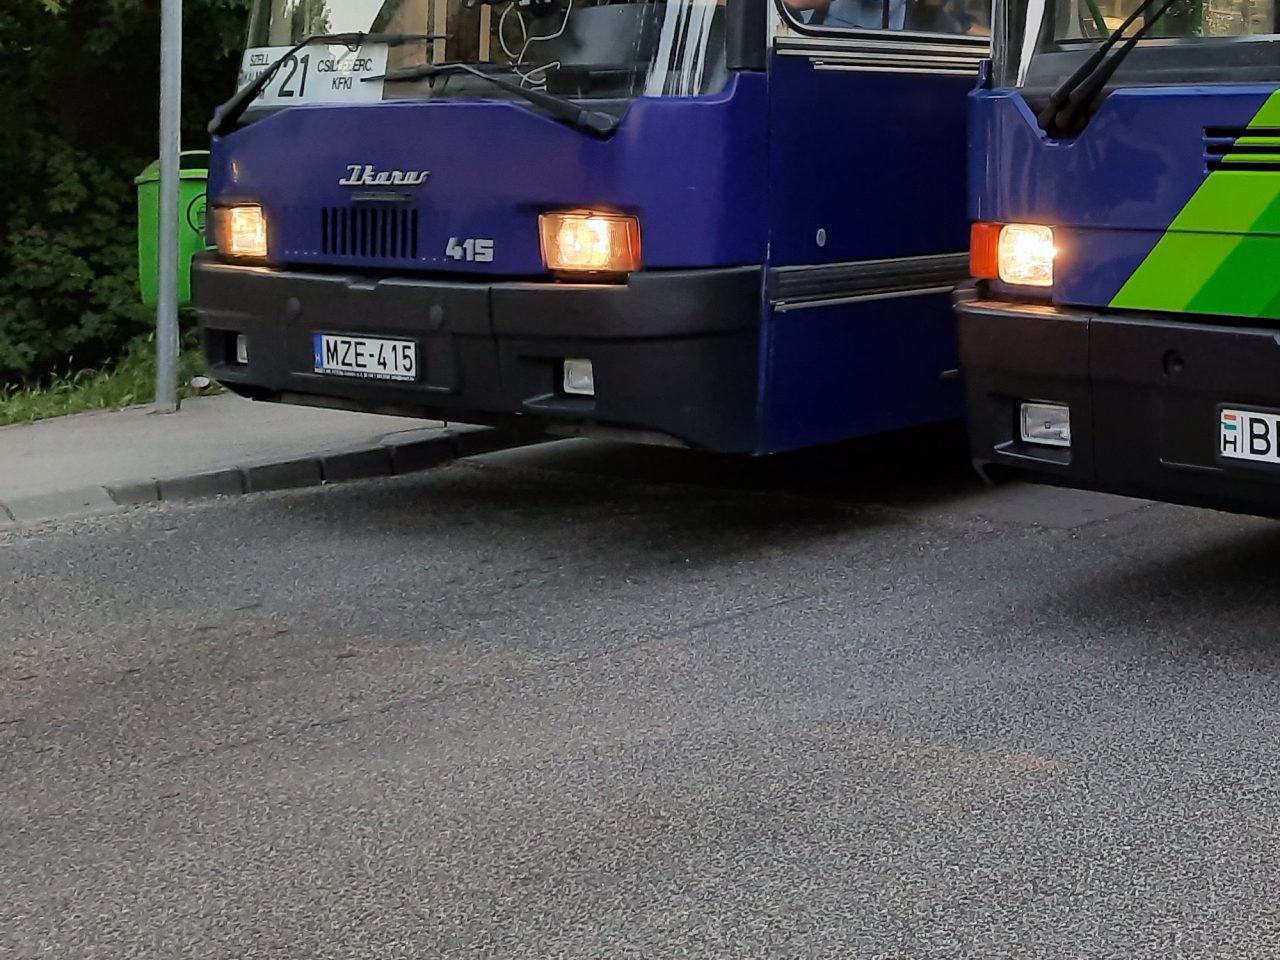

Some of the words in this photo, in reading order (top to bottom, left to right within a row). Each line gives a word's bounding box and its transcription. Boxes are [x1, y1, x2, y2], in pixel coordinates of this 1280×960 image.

[278, 54, 310, 97] 21
[331, 77, 353, 90] KFKI
[339, 165, 431, 185] Ikarus
[445, 237, 494, 262] 415
[325, 338, 413, 372] MZE-415
[1223, 433, 1238, 453] H
